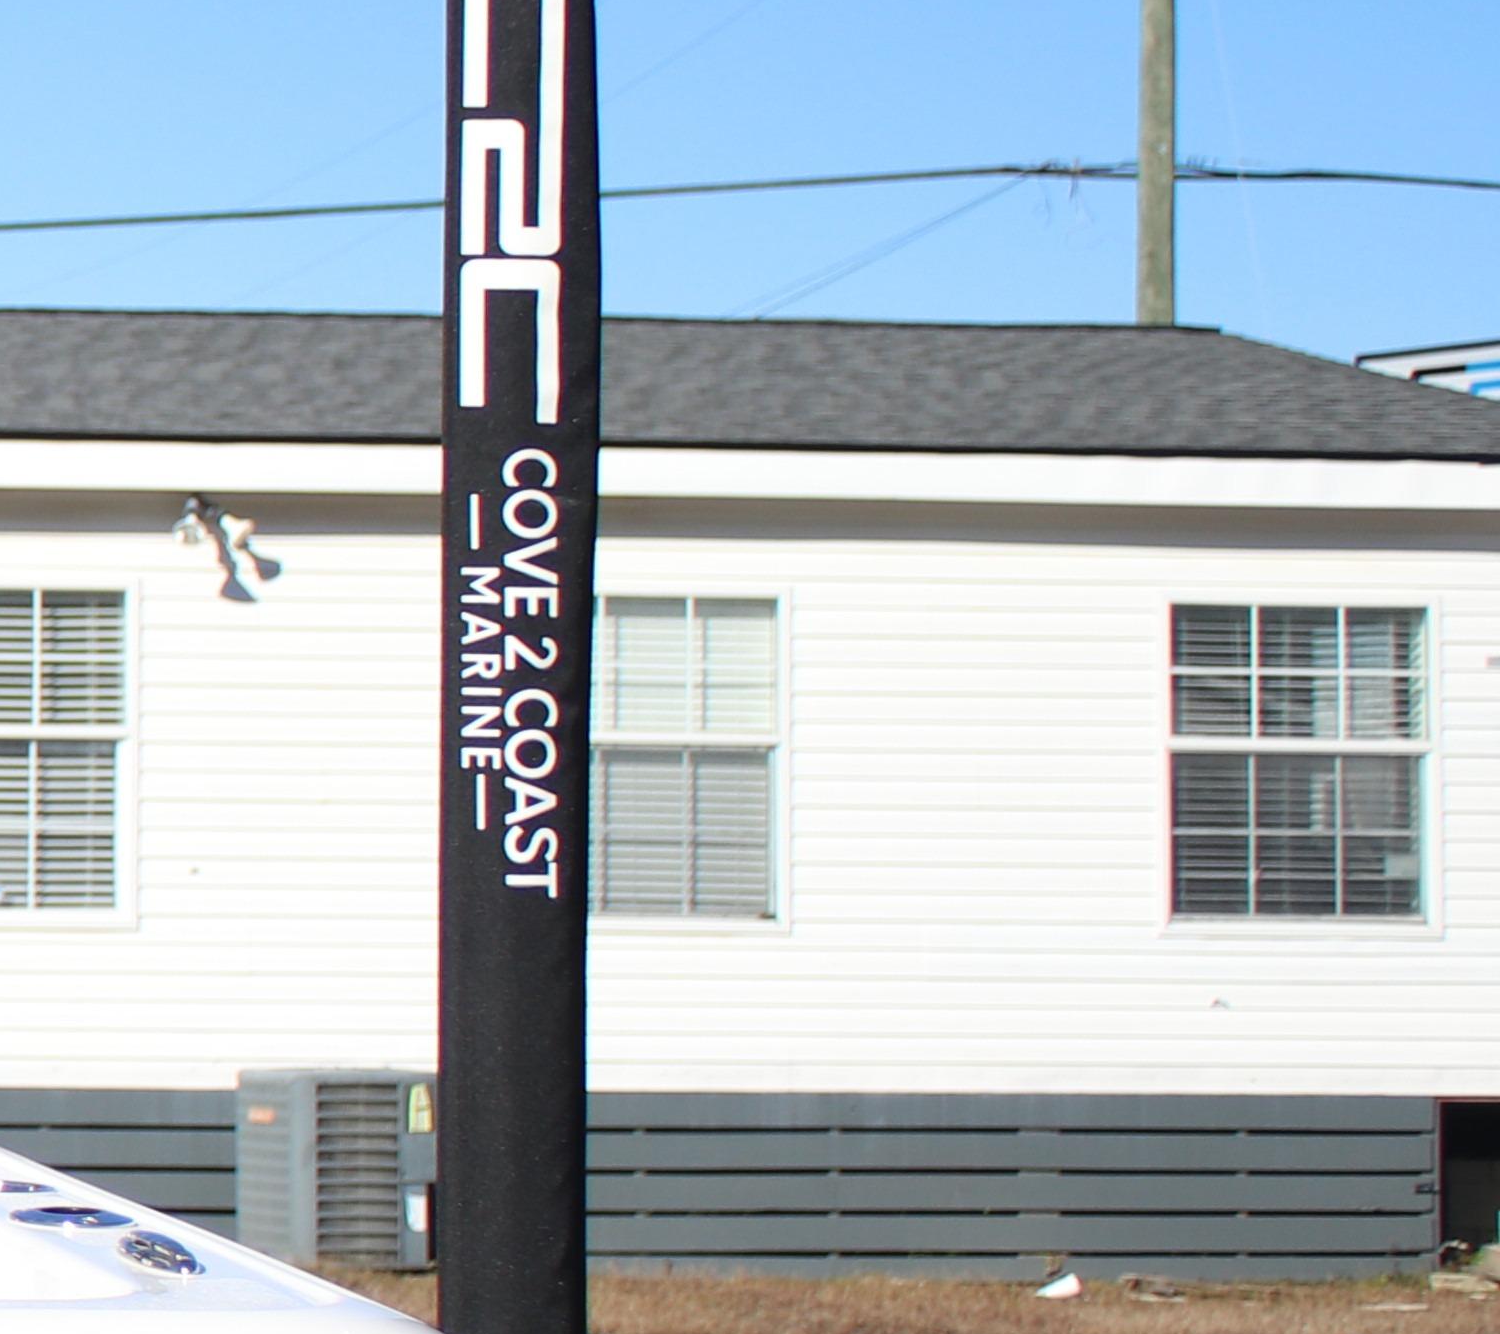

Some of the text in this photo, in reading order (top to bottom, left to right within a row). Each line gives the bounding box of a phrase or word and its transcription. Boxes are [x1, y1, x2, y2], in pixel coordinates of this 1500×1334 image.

[459, 565, 502, 770] MARINE
[501, 447, 560, 899] COVE 2 COAST
